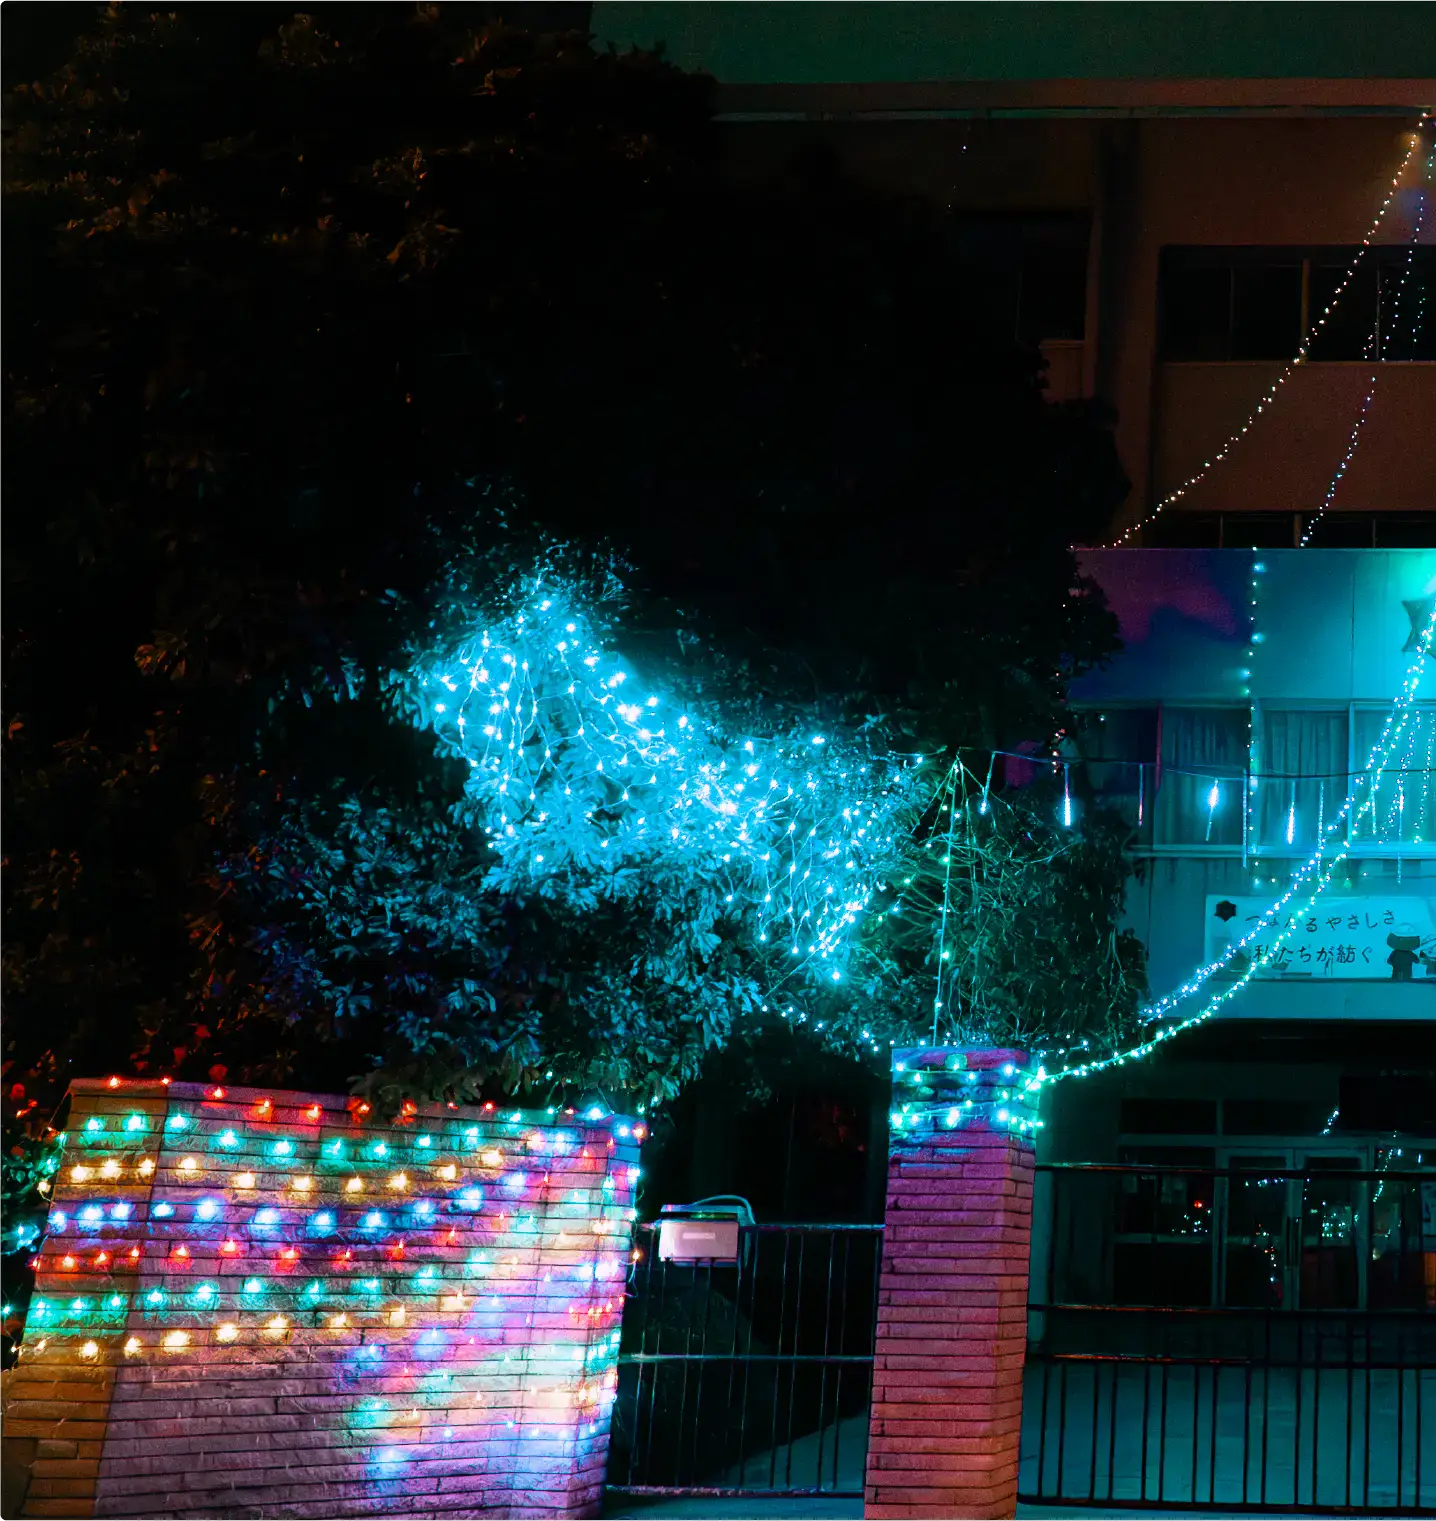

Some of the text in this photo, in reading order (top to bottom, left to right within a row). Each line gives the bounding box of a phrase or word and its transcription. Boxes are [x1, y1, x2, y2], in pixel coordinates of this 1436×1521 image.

[1253, 944, 1373, 964] 私たちが紡ぐ
